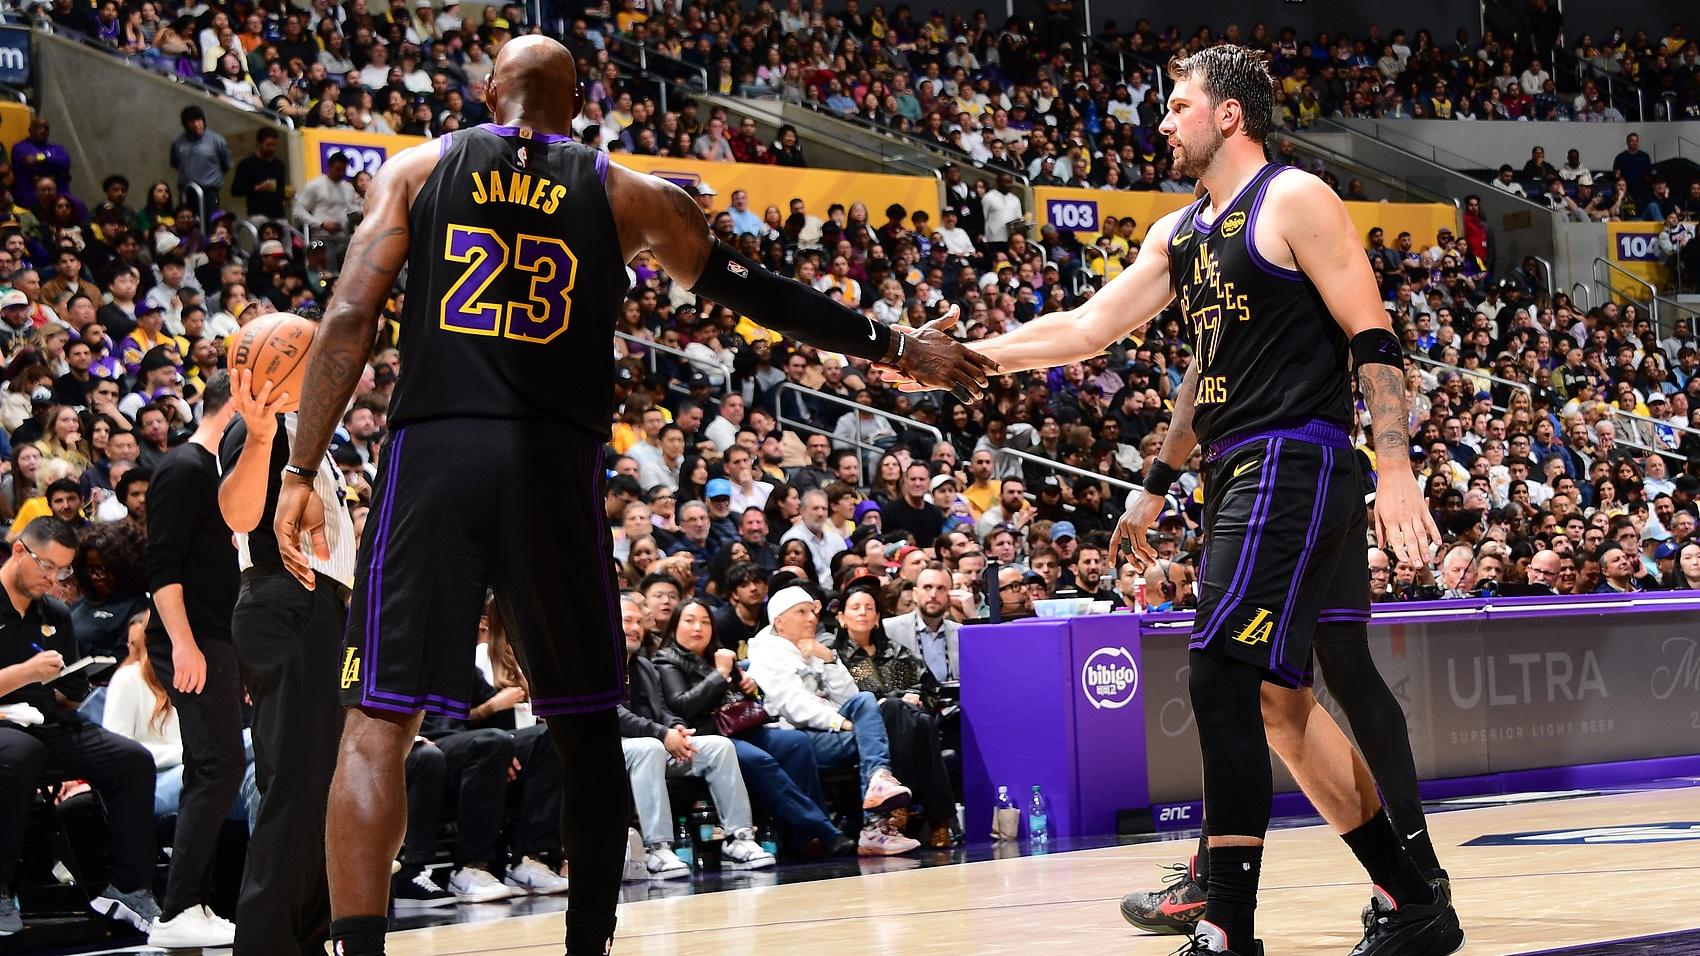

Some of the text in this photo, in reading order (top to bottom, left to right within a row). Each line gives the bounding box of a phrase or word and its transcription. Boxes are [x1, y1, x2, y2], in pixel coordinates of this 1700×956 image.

[327, 147, 382, 178] 02
[471, 170, 567, 214] JAMES
[1052, 203, 1094, 228] 103
[440, 223, 578, 345] 23
[1231, 607, 1274, 646] LA
[340, 646, 361, 689] LA
[1087, 663, 1134, 690] bibigo
[1447, 649, 1609, 710] ULTRA
[1450, 719, 1616, 745] SUPERIOR LIGHT BEER
[1159, 805, 1191, 821] anc
